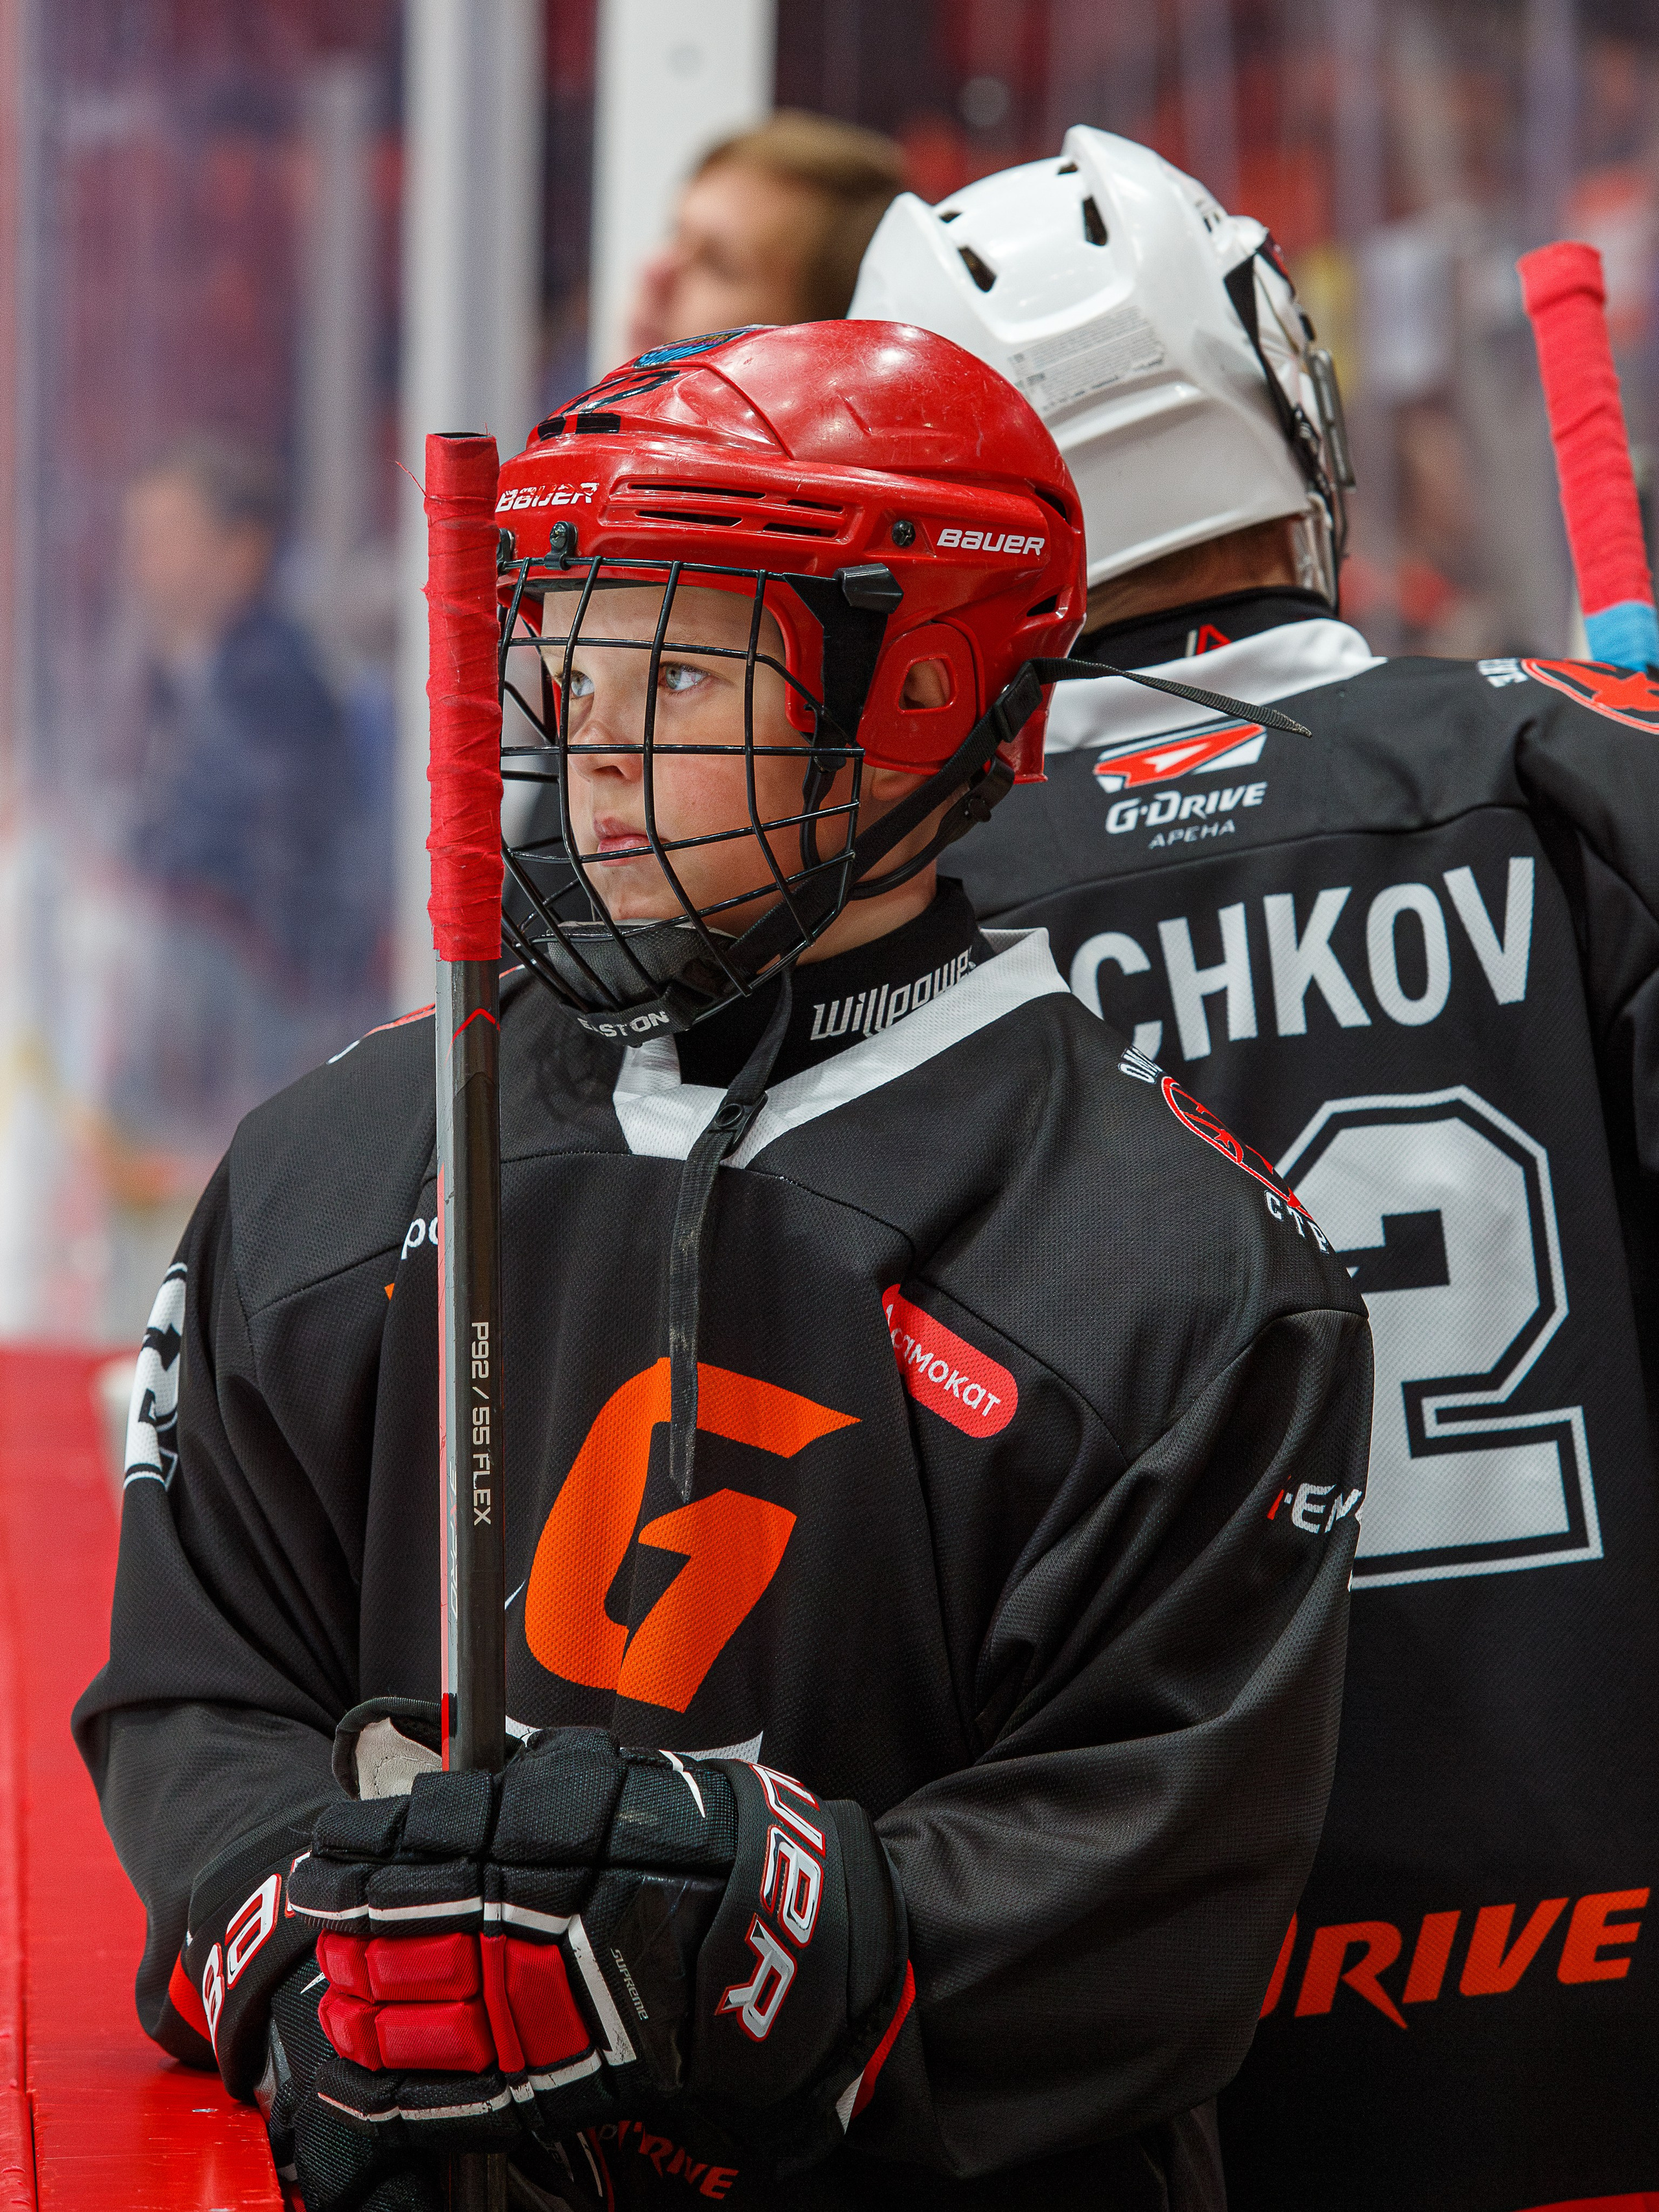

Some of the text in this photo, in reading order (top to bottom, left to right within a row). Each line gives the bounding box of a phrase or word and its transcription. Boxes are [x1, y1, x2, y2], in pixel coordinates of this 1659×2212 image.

[1070, 857, 1535, 1061] CHKOV
[472, 1321, 489, 1379] P92
[1271, 1085, 1604, 1590] 2
[472, 1406, 490, 1445] 55
[473, 1453, 491, 1526] FLEX
[610, 1948, 649, 2021] SUPREME
[1259, 1887, 1651, 2030] RIVE
[618, 2120, 741, 2200] RIVE
